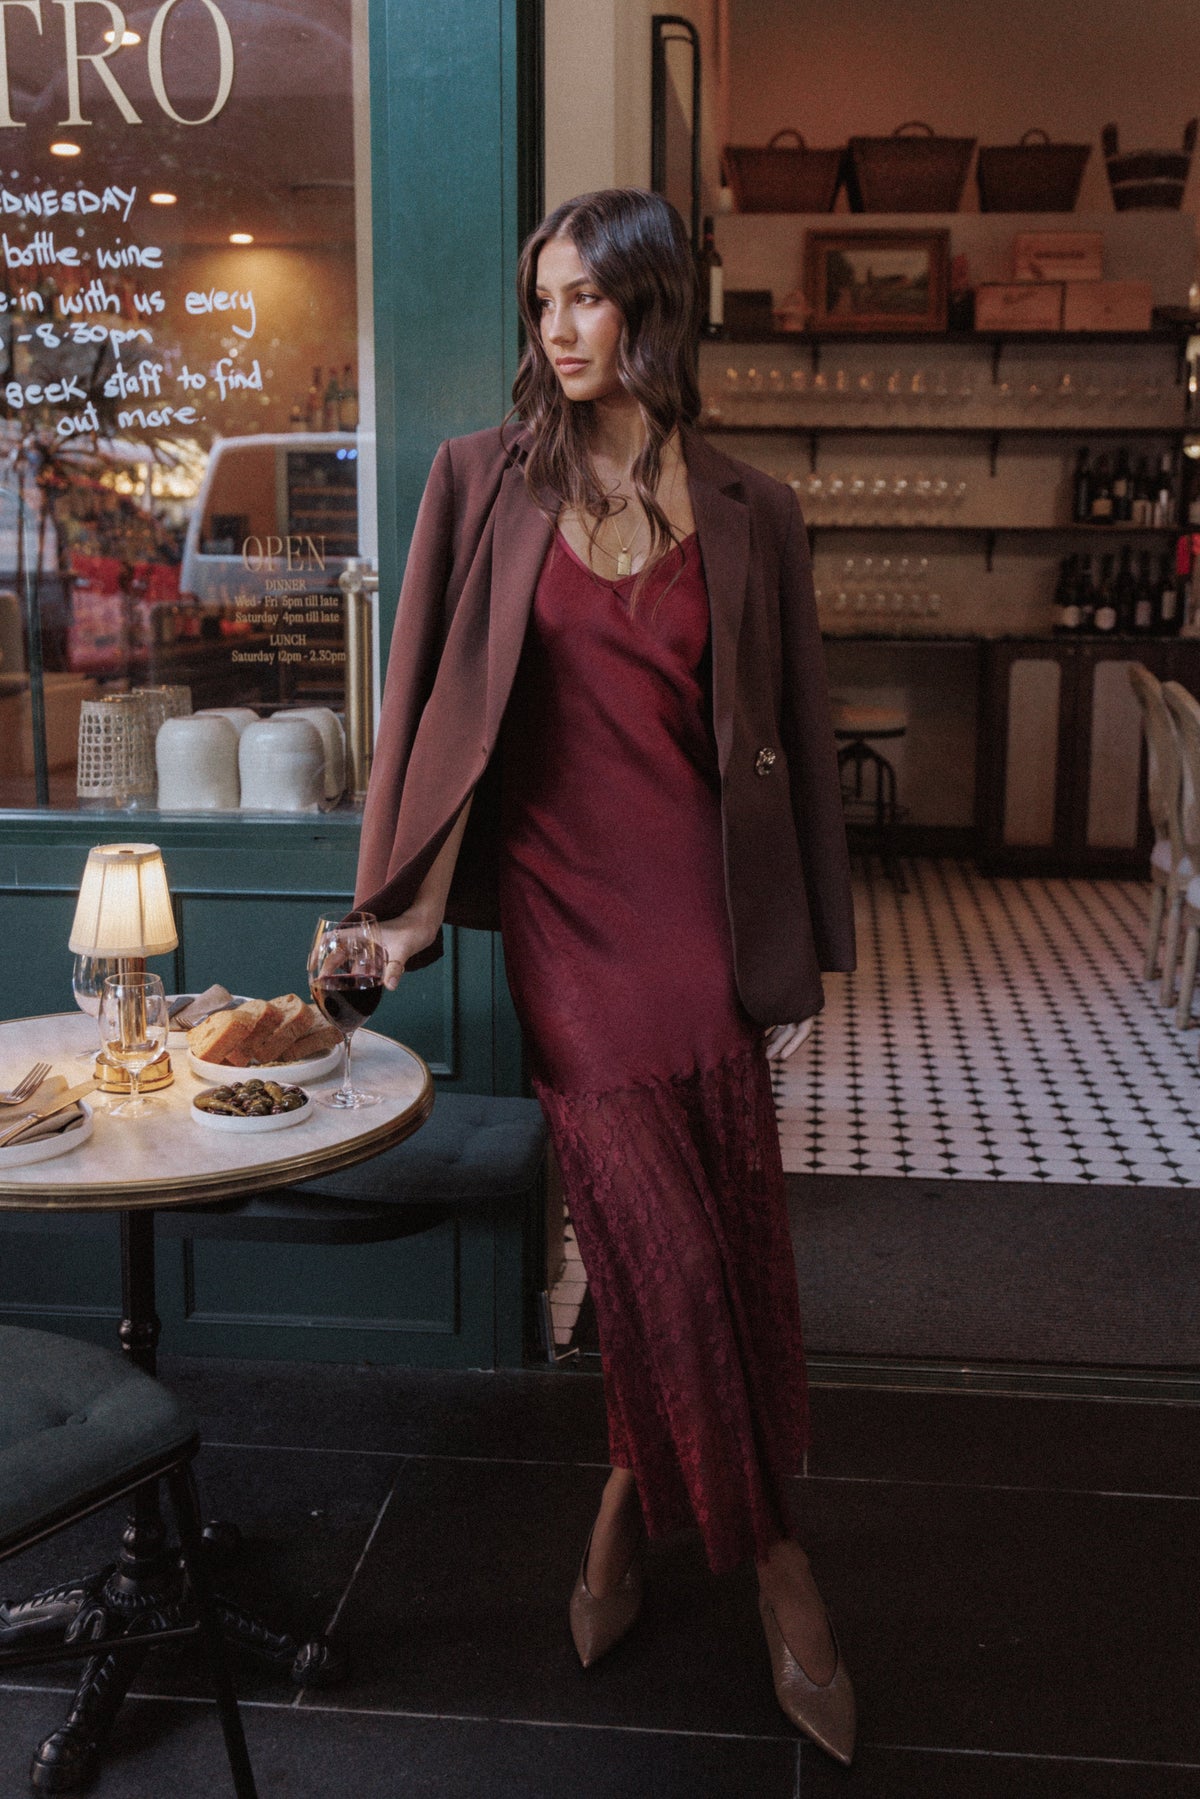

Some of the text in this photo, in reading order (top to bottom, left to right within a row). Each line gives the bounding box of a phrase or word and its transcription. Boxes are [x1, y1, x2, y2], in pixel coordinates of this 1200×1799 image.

[0, 185, 136, 222] DNESDAY
[2, 230, 163, 269] bottle wine
[59, 278, 120, 315] with
[133, 290, 165, 315] us
[185, 287, 256, 339] every
[104, 360, 163, 399] staff
[177, 365, 206, 390] to
[215, 358, 263, 401] find
[57, 401, 99, 436] out
[242, 535, 326, 573] OPEN
[234, 594, 257, 607] Wed
[264, 595, 278, 607] Fri
[282, 595, 303, 610] 5pm
[305, 594, 318, 607] till
[320, 594, 339, 607] late
[266, 580, 307, 591] DINNER
[235, 611, 340, 625] Saturday 4pm till late
[231, 650, 276, 665] Saturday
[278, 650, 302, 664] 12pm
[309, 649, 346, 664] 2.30pm
[270, 634, 307, 646] LUNCH
